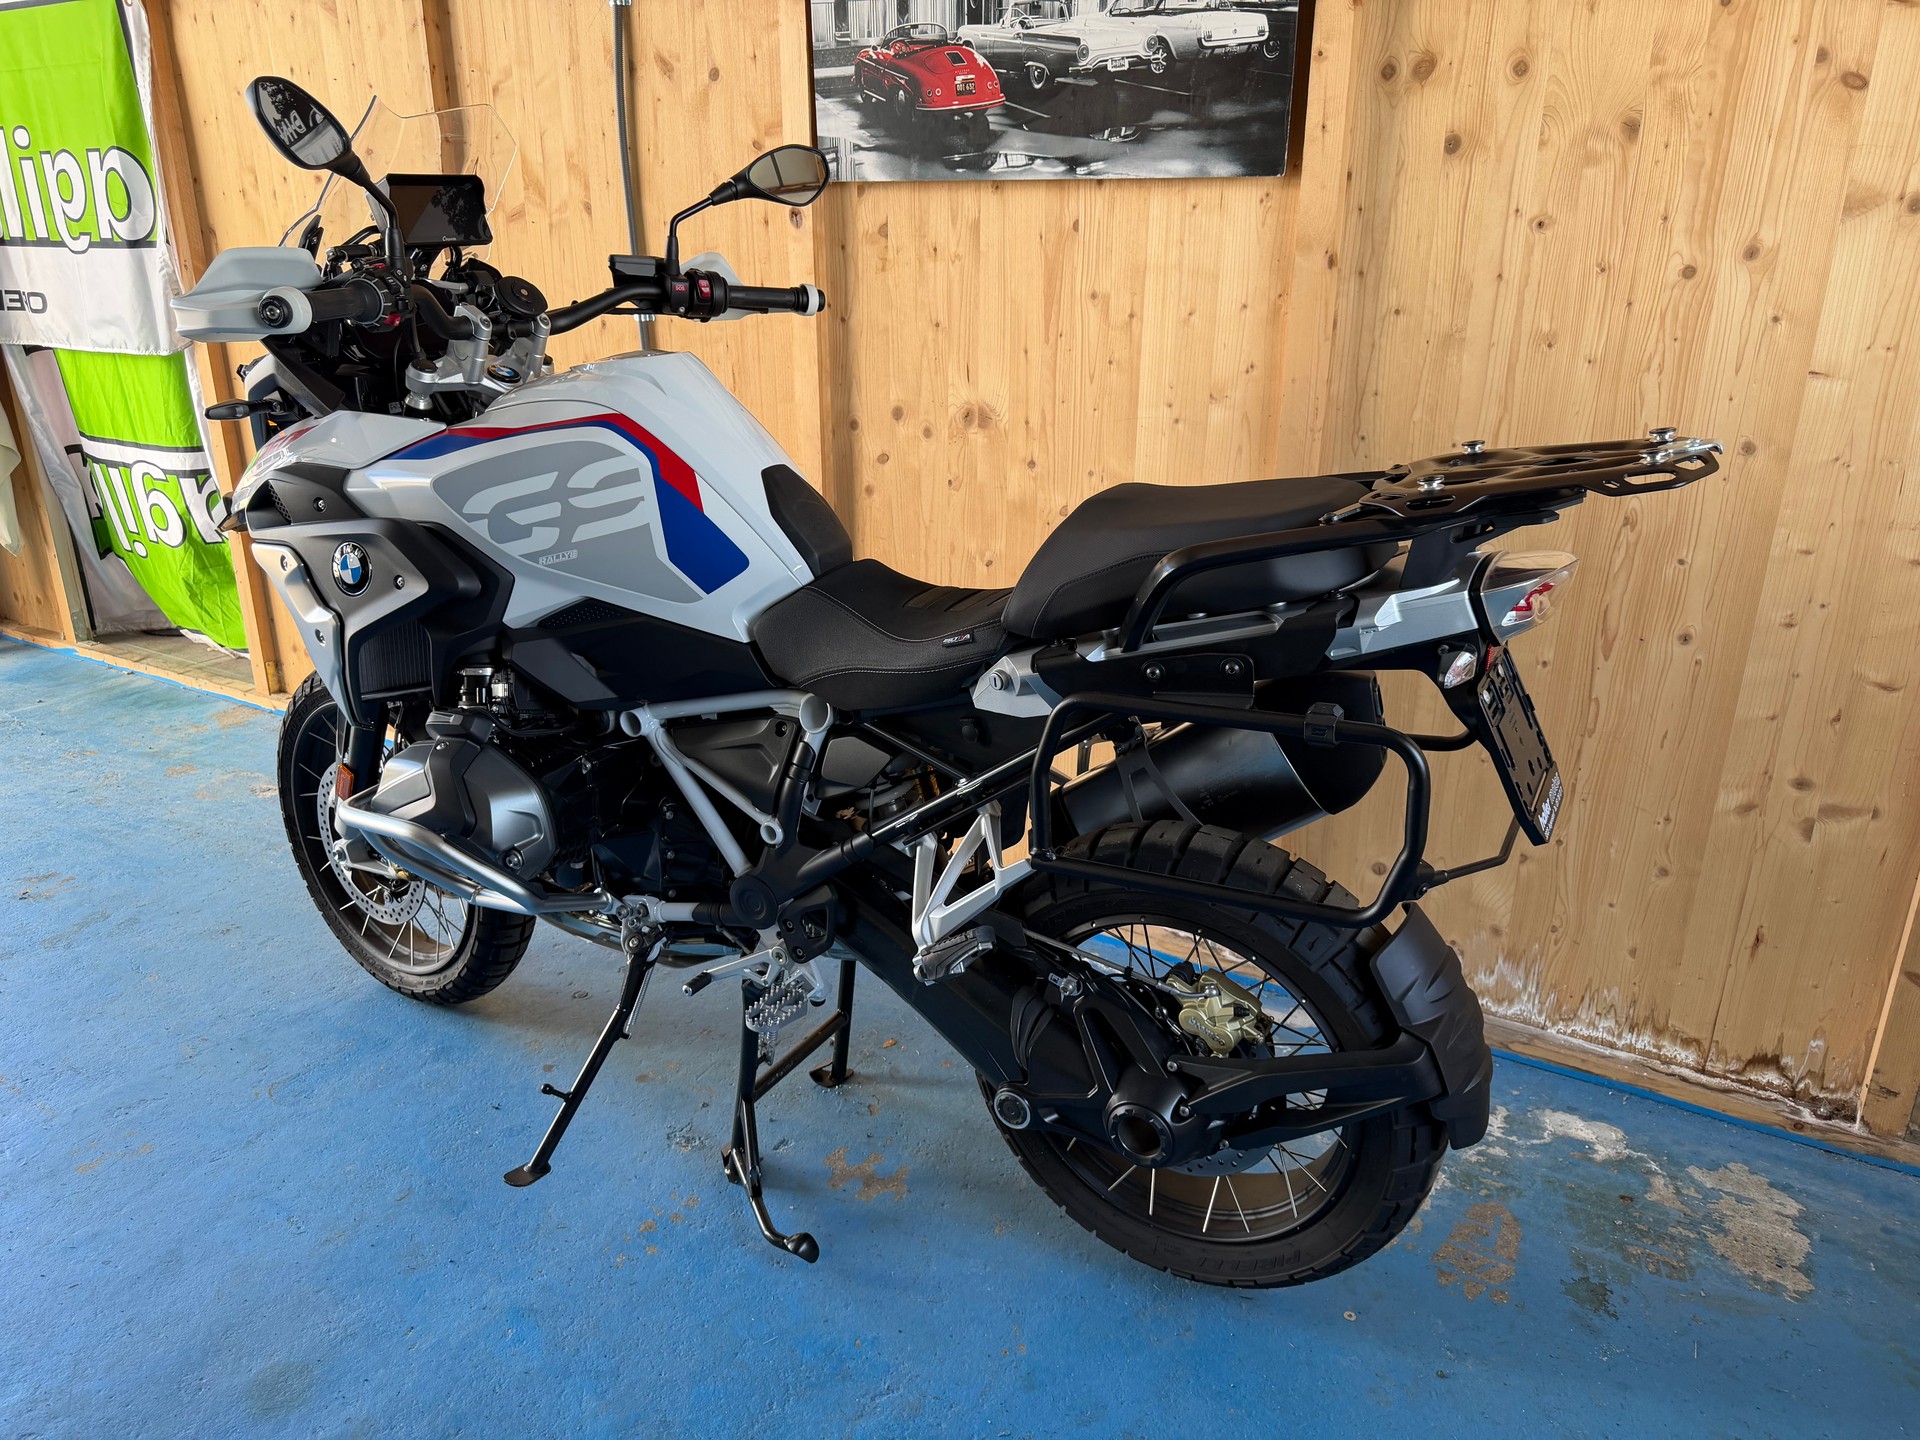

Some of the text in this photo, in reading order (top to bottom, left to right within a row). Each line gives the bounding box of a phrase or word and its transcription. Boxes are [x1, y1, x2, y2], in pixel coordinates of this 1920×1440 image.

[90, 460, 226, 559] agil
[463, 455, 651, 556] GS
[539, 549, 578, 566] RALLYE
[1188, 1016, 1226, 1046] brembo
[1197, 1249, 1301, 1273] PIRELLI
